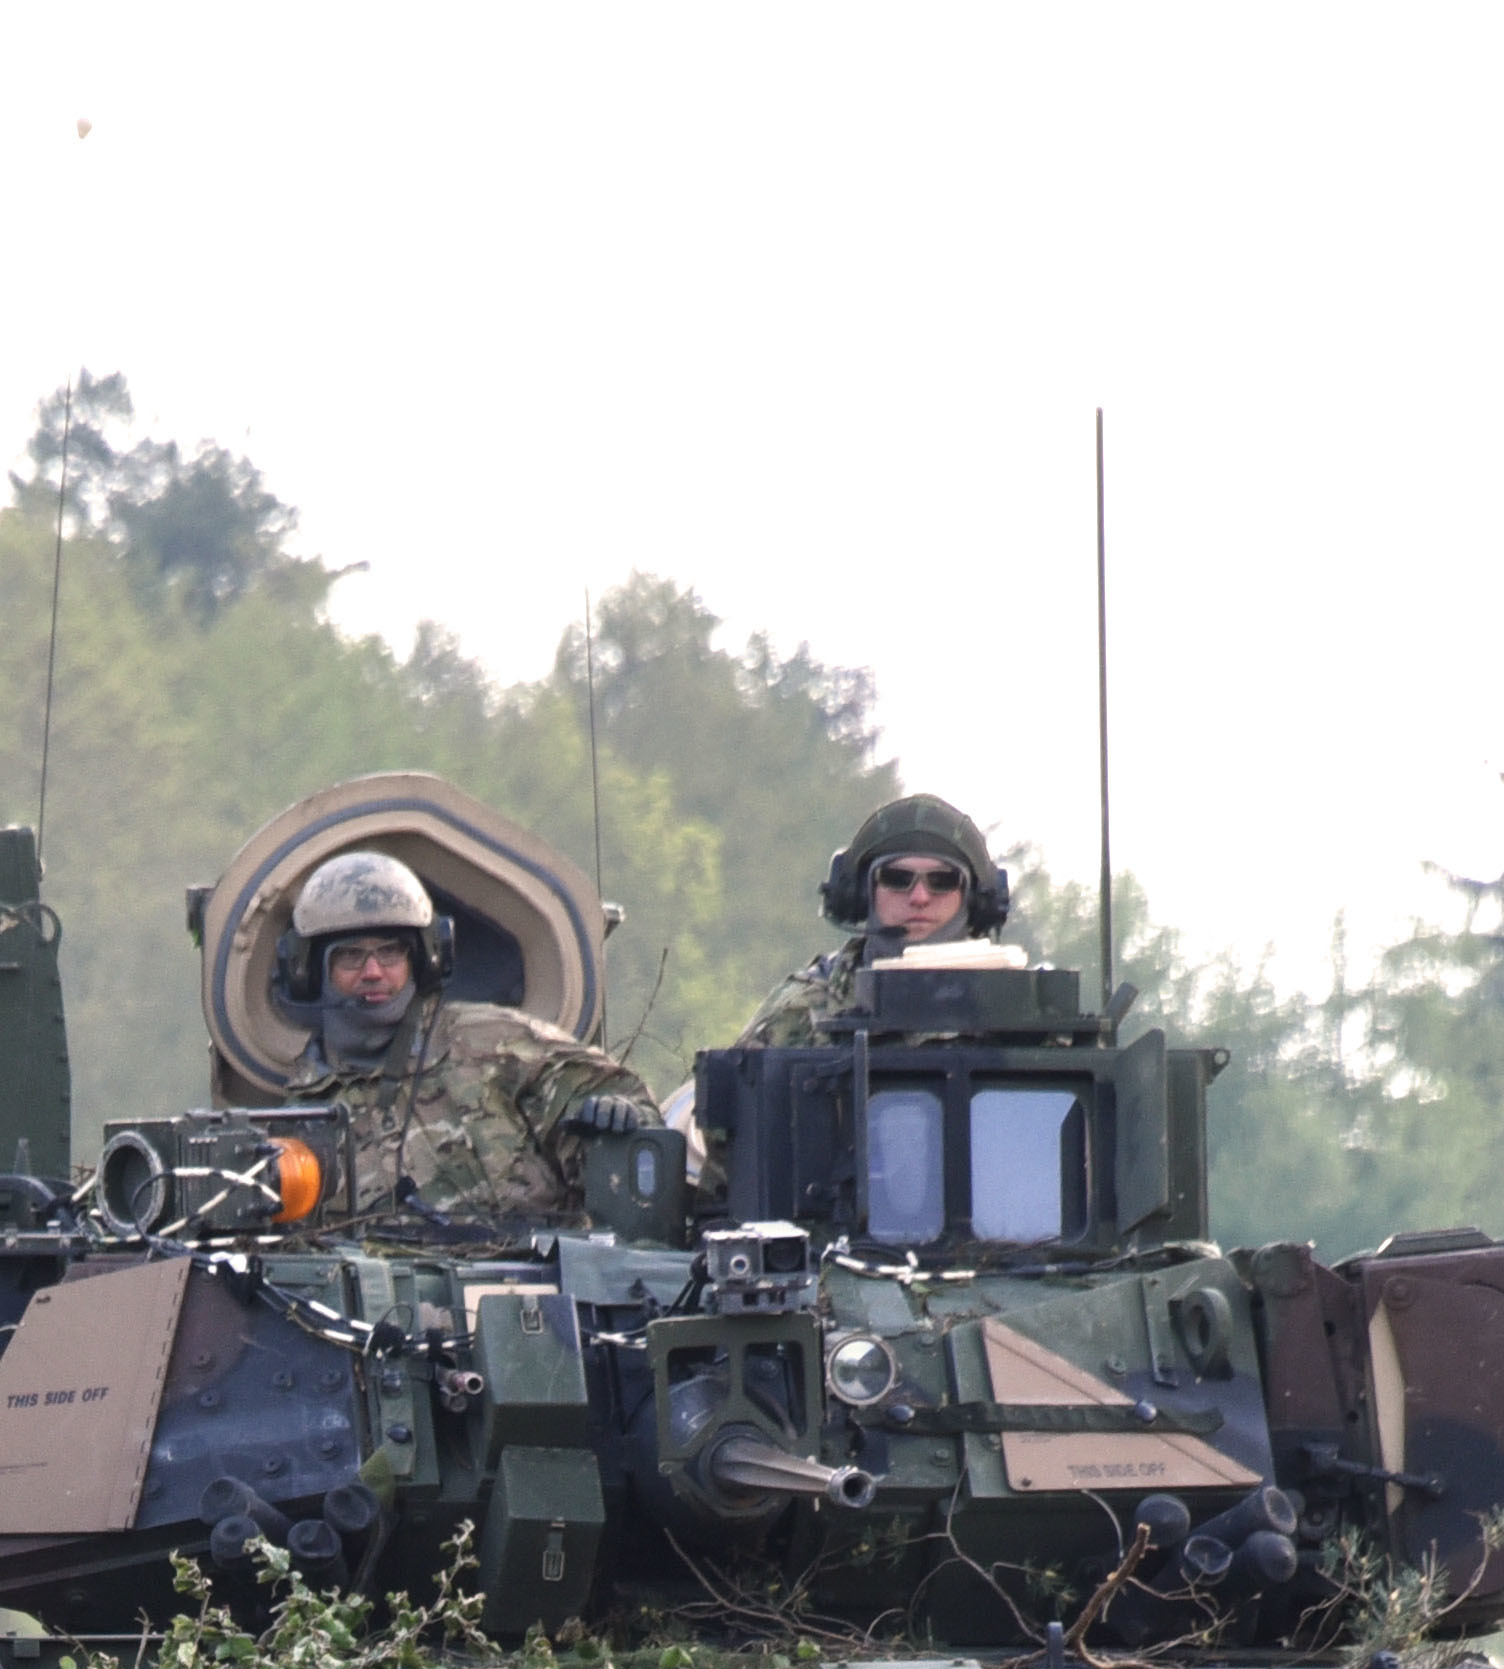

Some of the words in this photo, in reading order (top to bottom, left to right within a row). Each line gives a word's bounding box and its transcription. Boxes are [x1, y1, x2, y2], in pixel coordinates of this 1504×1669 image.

[7, 1394, 39, 1409] THIS
[44, 1390, 76, 1405] SIDE
[81, 1387, 109, 1402] OFF
